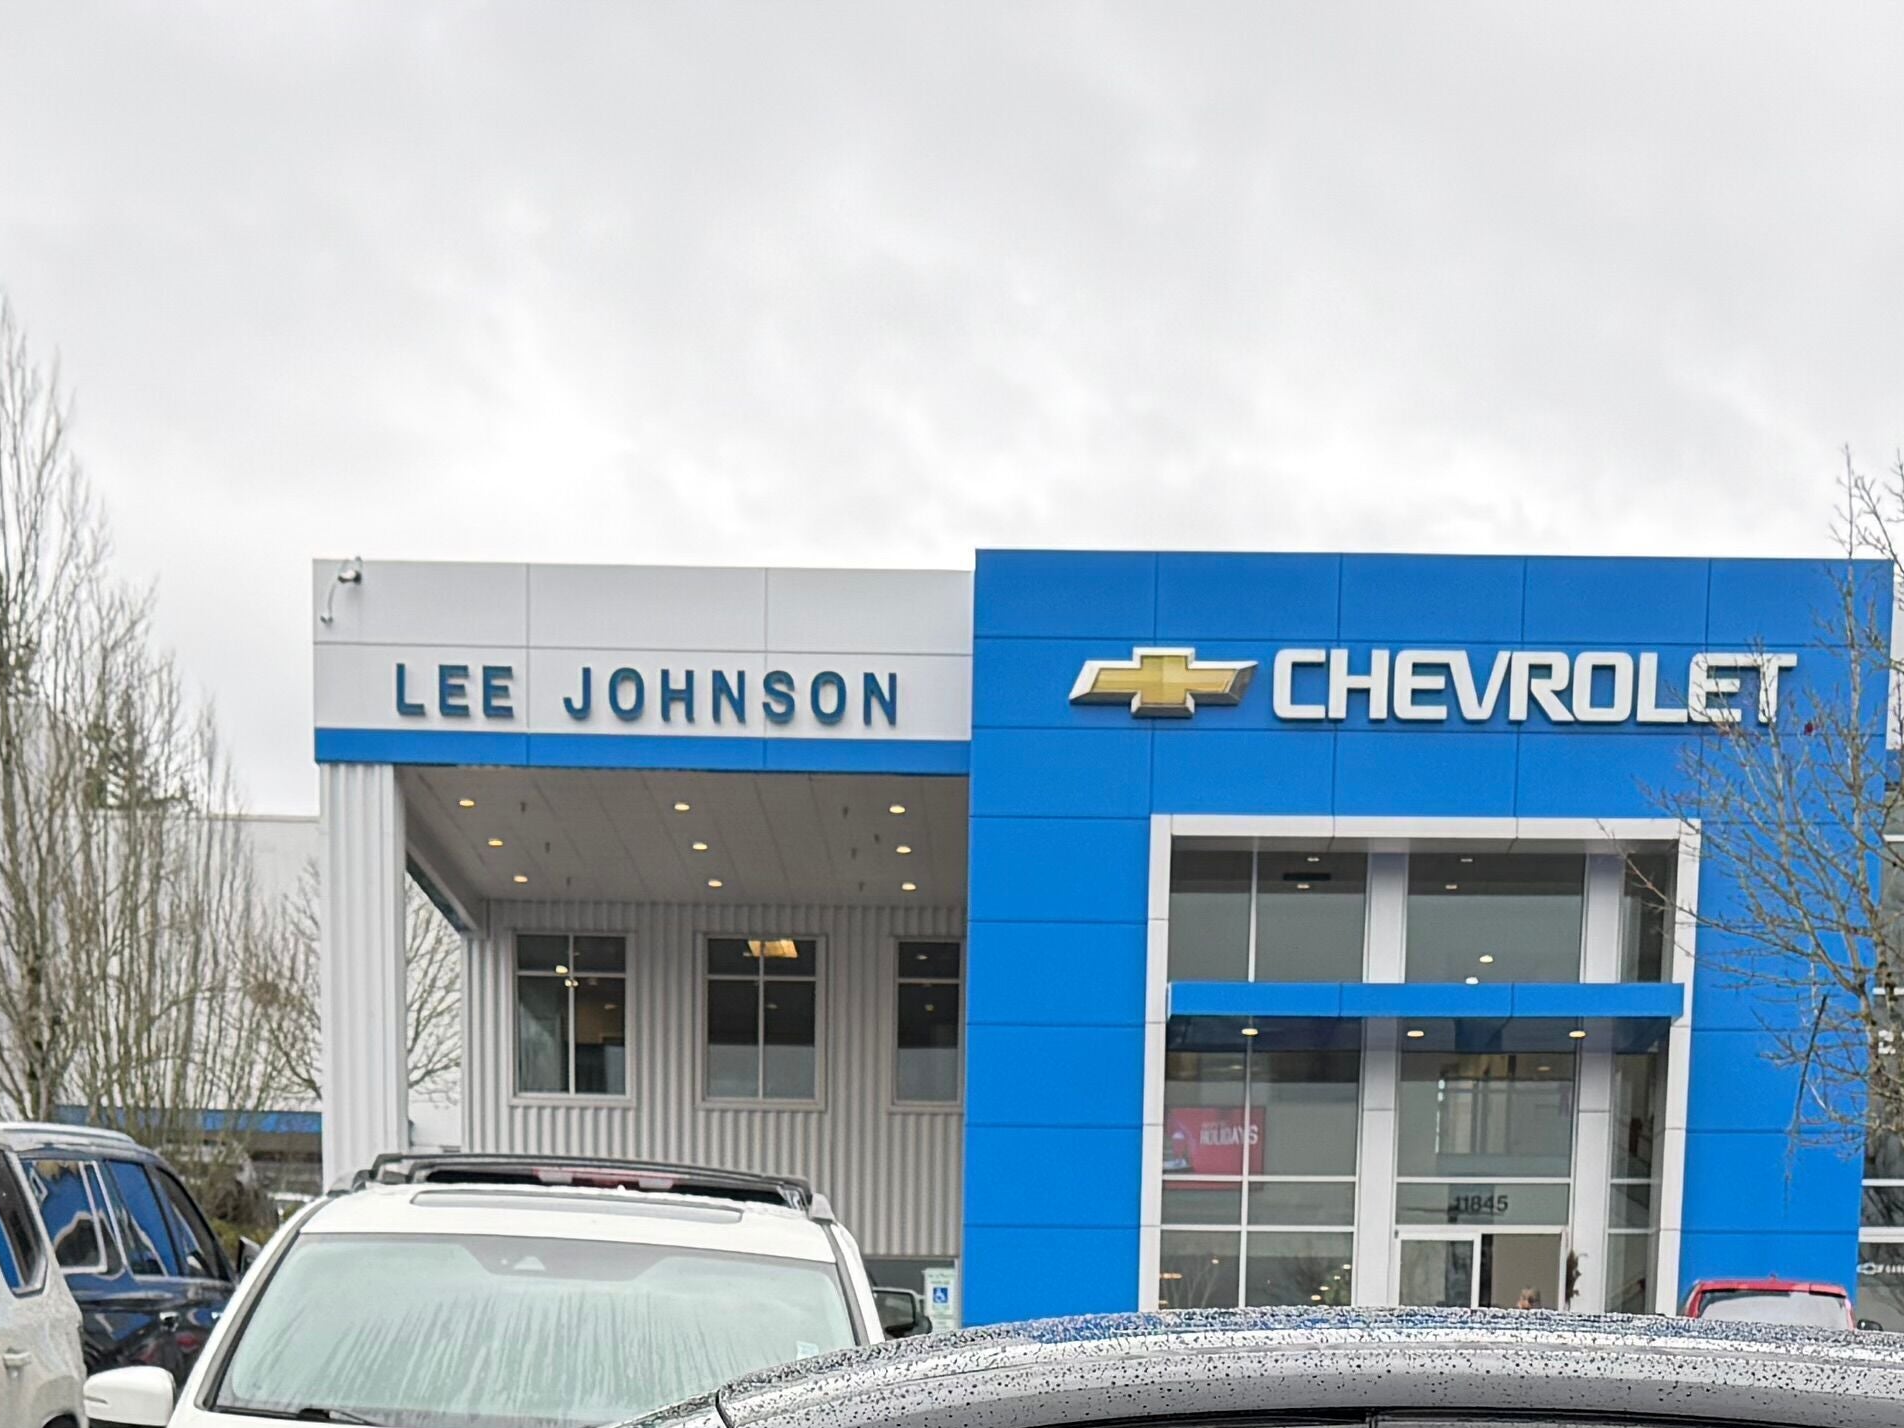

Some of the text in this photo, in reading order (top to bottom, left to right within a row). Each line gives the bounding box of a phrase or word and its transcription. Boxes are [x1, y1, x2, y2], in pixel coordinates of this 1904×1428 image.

[396, 662, 898, 725] LEE JOHNSON
[1273, 648, 1798, 724] CHEVROLET
